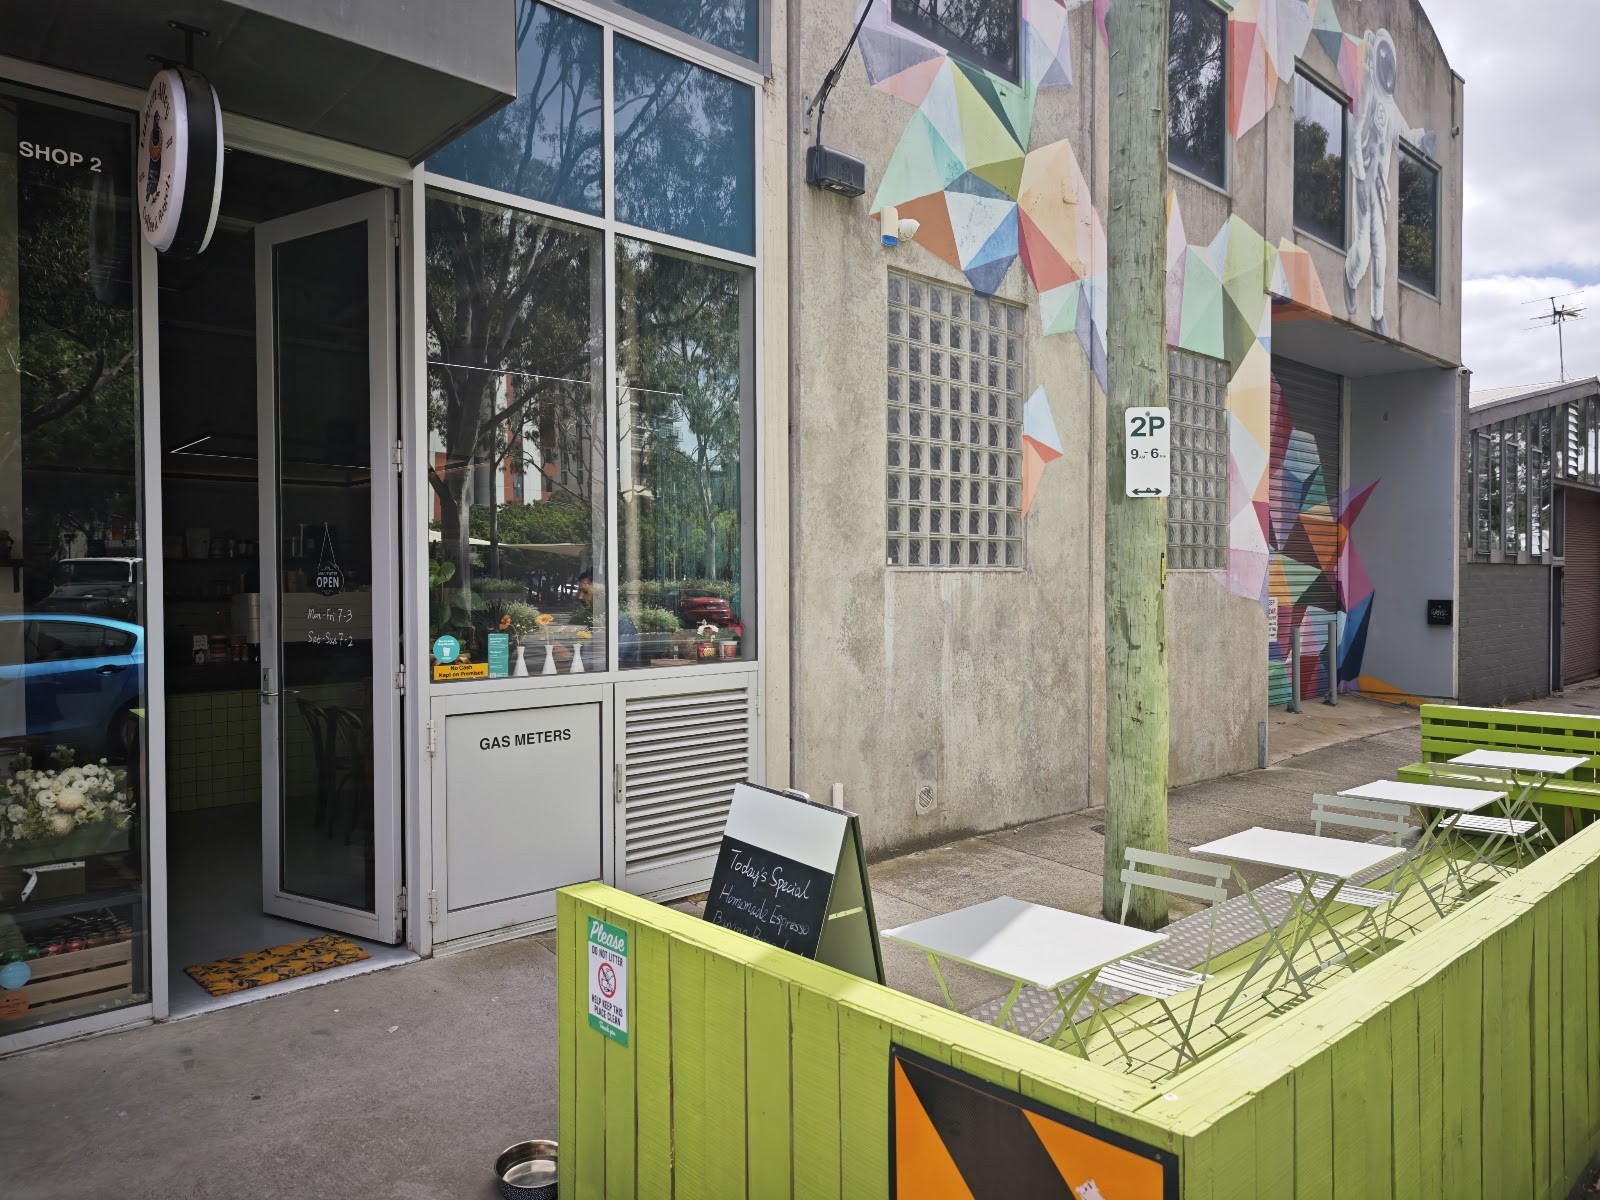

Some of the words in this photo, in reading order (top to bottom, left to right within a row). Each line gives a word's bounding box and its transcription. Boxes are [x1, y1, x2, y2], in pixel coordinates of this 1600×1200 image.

[19, 141, 84, 167] SHOP
[90, 157, 102, 173] 2
[1130, 416, 1165, 437] 2P
[316, 576, 340, 588] OPEN
[479, 735, 511, 751] GAS
[514, 728, 572, 747] METERS
[730, 848, 768, 888] Today's
[769, 866, 810, 900] Special
[719, 883, 769, 923] Homemade
[769, 904, 810, 936] Espresso
[589, 920, 625, 952] Please
[591, 945, 598, 956] DO
[598, 947, 608, 960] NOT
[591, 994, 602, 1006] HELP
[602, 999, 613, 1011] KEEP
[613, 1005, 623, 1018] THIS
[594, 1004, 606, 1019] PLACE
[606, 1011, 621, 1027] CLEAN
